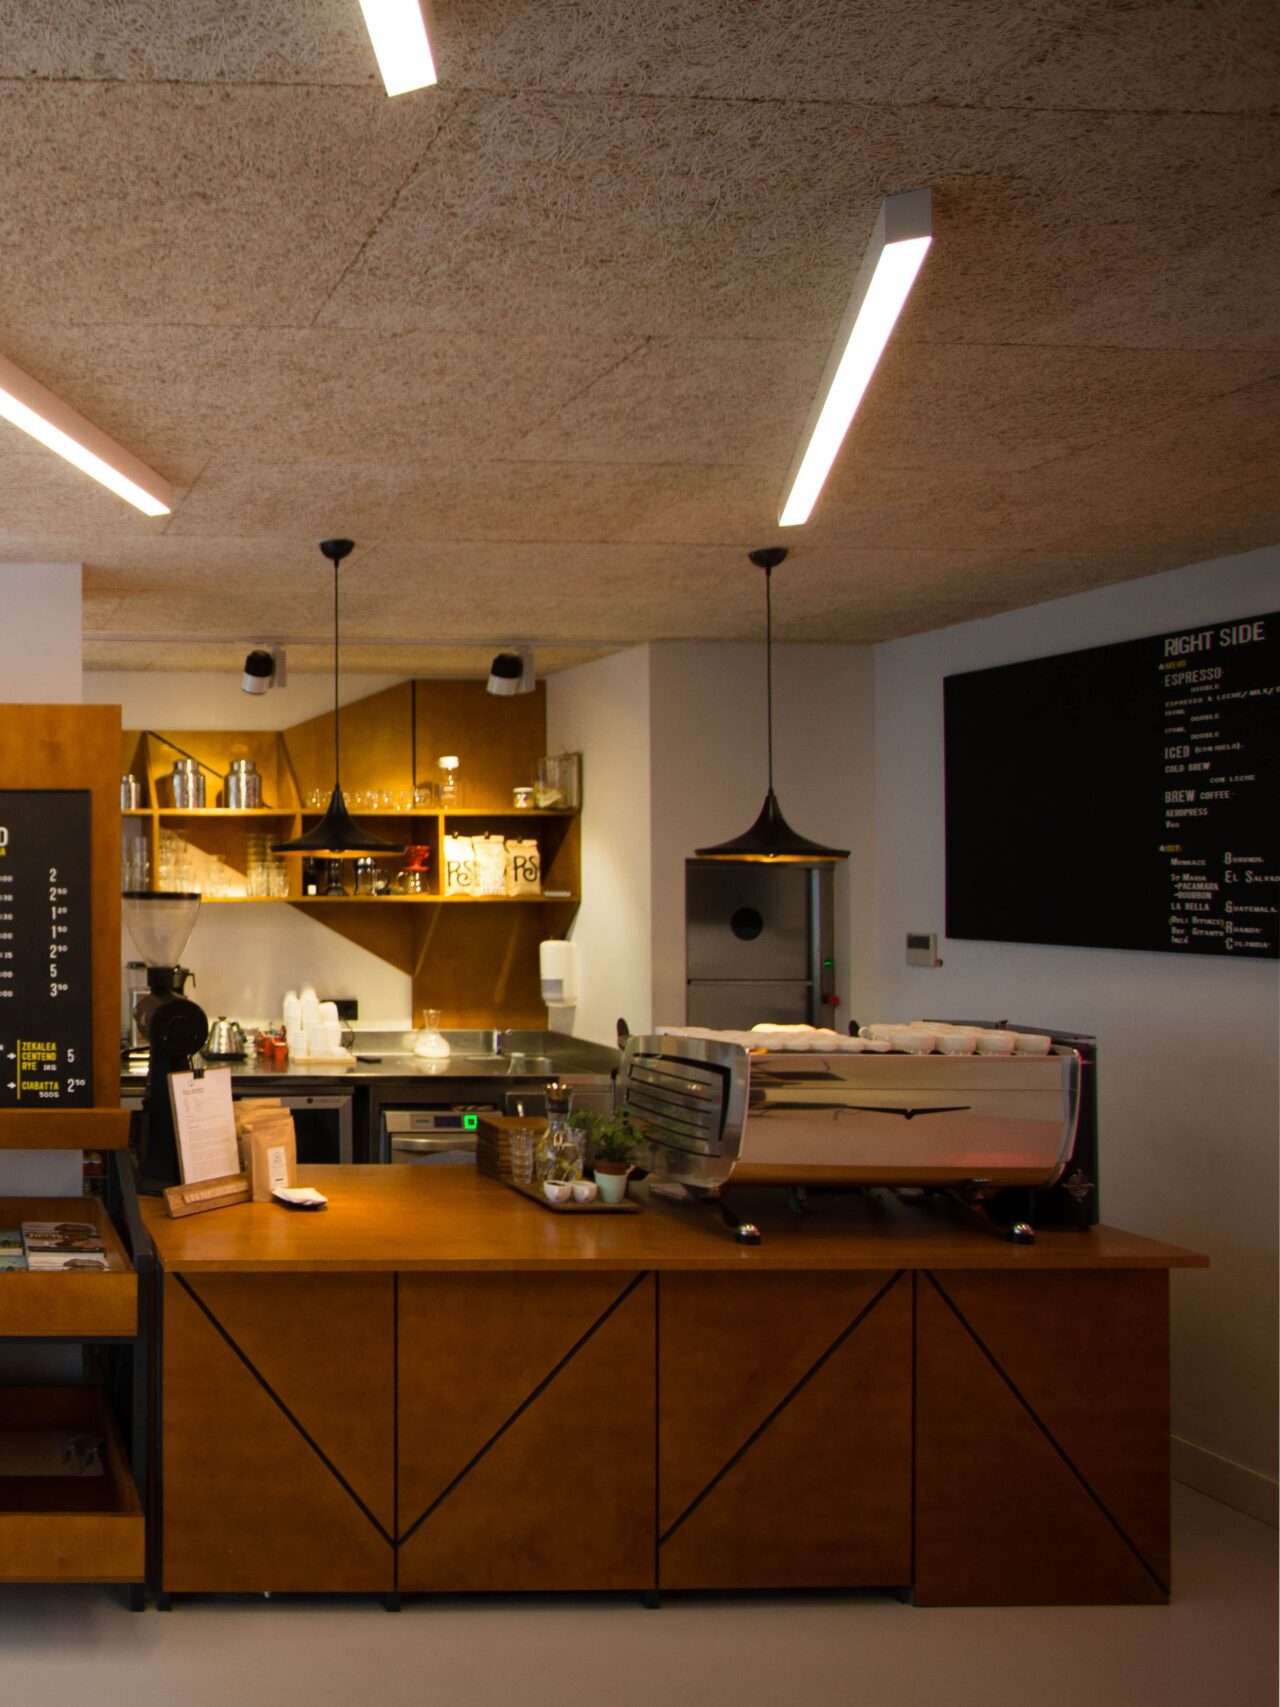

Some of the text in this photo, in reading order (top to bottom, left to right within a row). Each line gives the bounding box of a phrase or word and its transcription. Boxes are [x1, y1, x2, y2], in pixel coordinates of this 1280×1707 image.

[1164, 621, 1265, 657] RIGHT SIDE
[1164, 667, 1223, 688] ESPRESSO
[1164, 697, 1204, 708] ESPRESSO
[1164, 745, 1191, 760] ICED
[1164, 762, 1211, 774] COLD BREW
[1164, 789, 1231, 804] BREW COFFEE
[1165, 808, 1209, 818] AEROPRESS
[49, 867, 57, 882] 2
[1170, 902, 1210, 911] LA BELLA
[49, 963, 58, 978] 5
[21, 1042, 57, 1051] ZEKALEA
[21, 1052, 57, 1062] CENTENO
[67, 1048, 75, 1063] 5
[21, 1062, 37, 1071] RYE
[21, 1081, 60, 1090] CIABATTA
[38, 1091, 60, 1099] 500G
